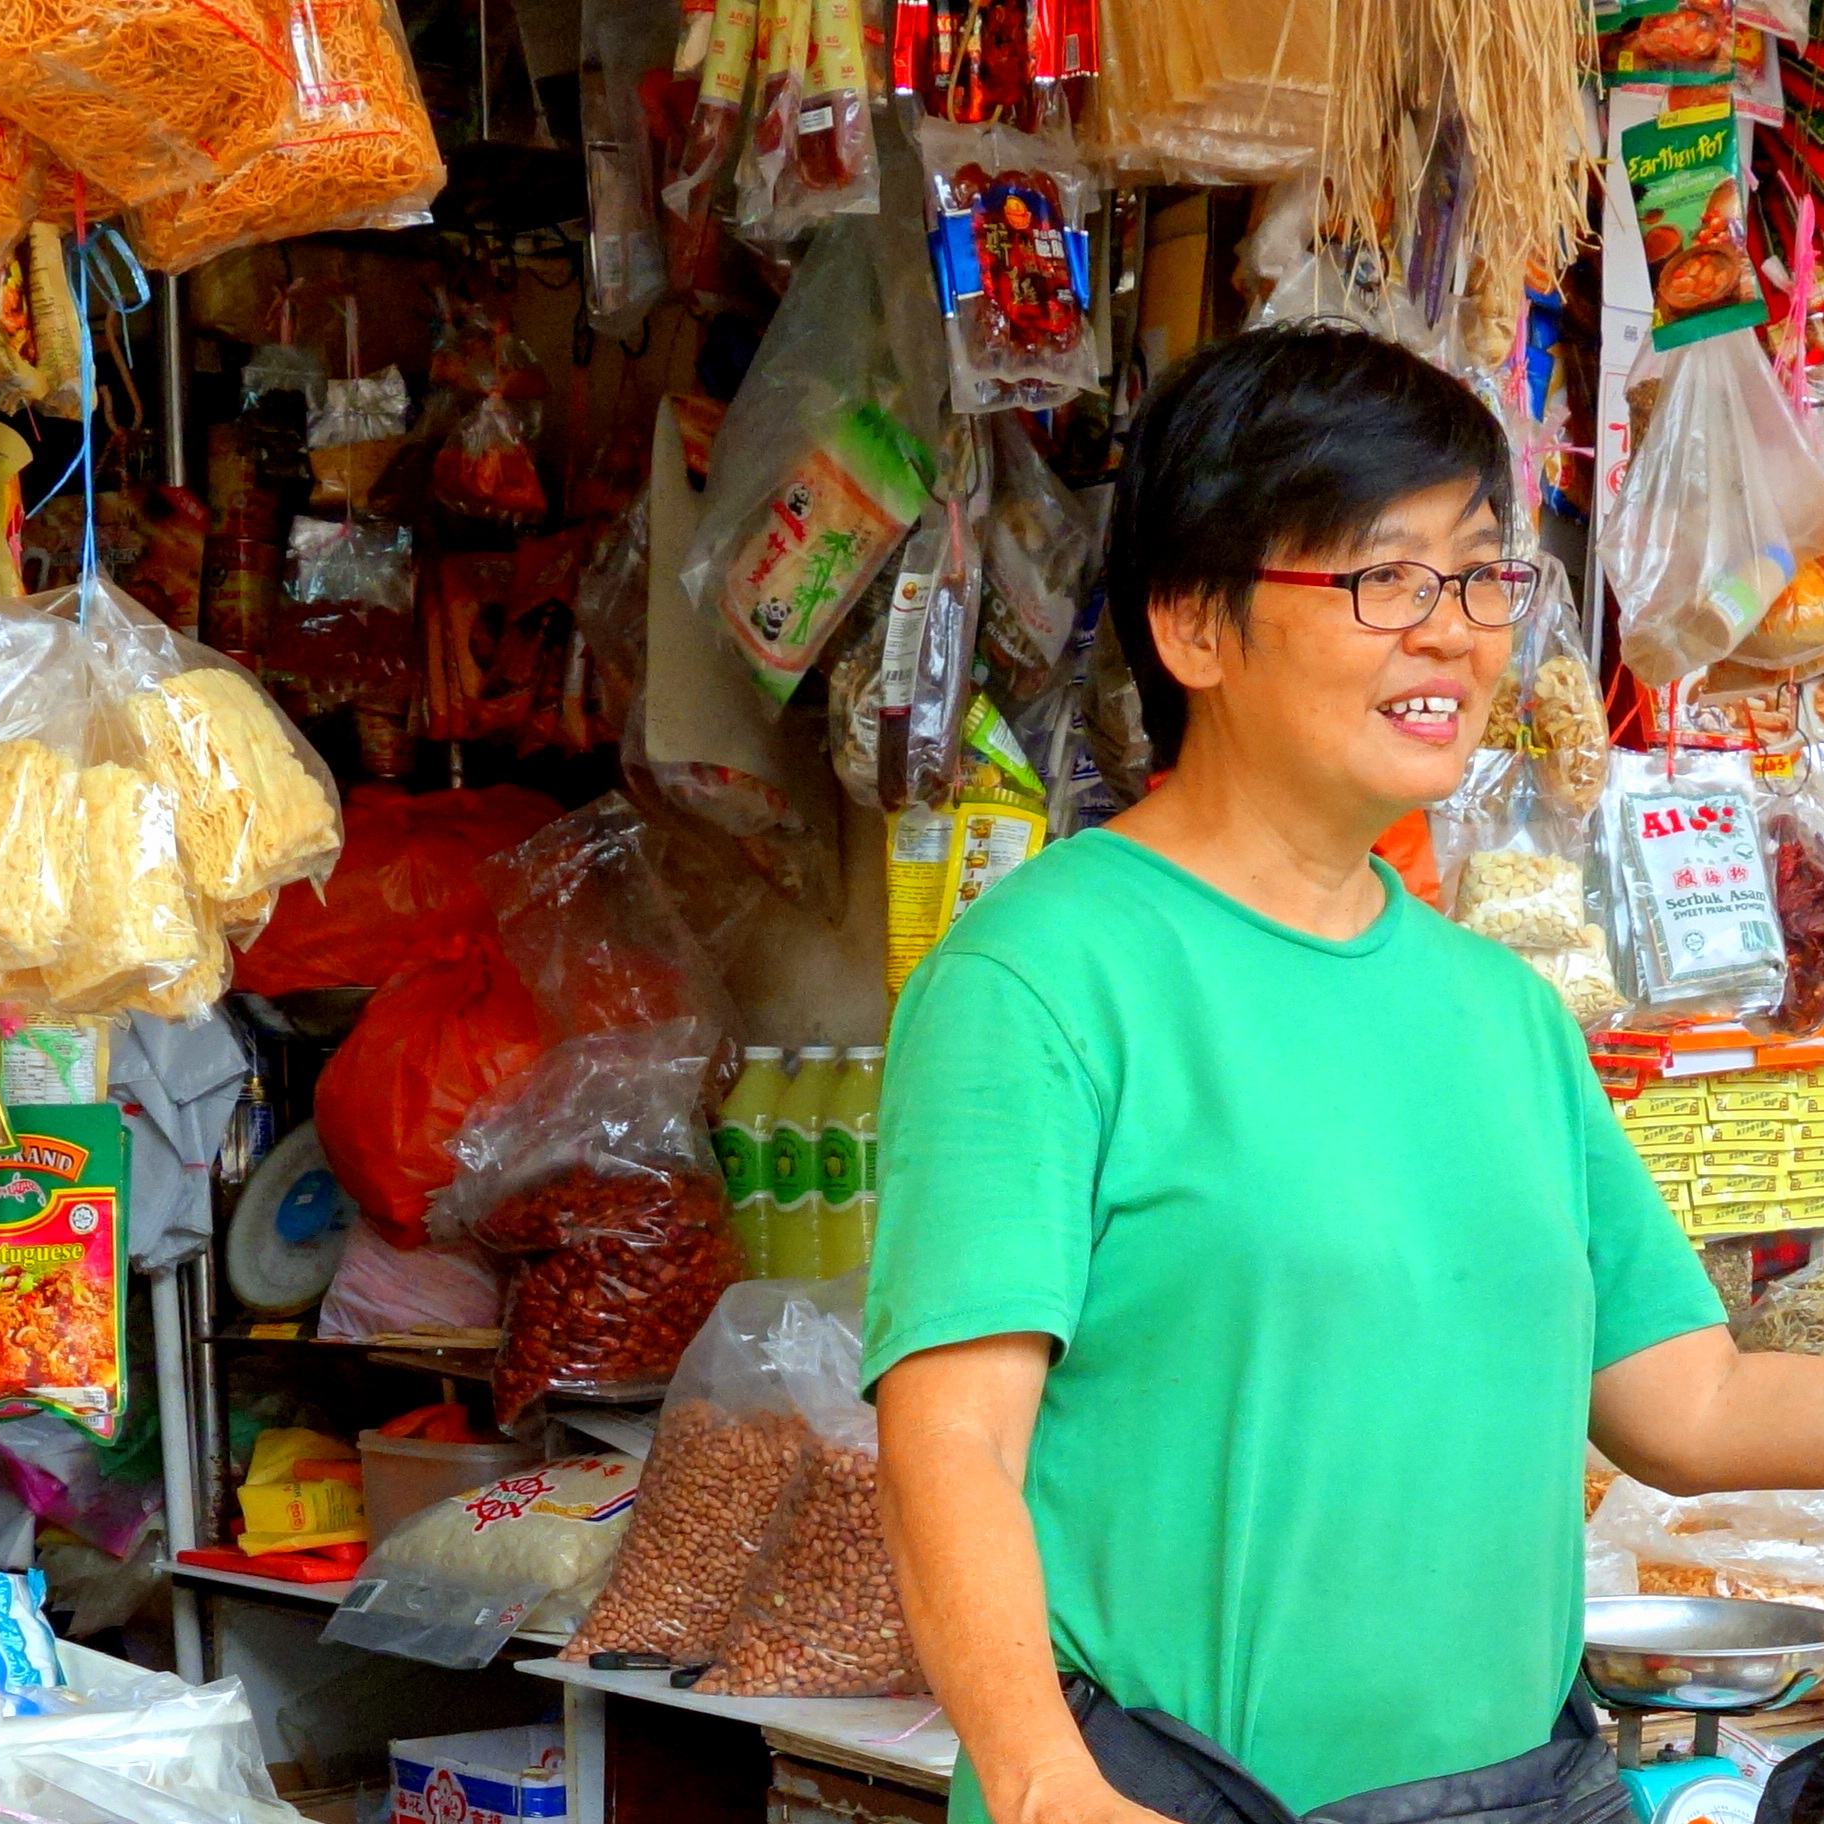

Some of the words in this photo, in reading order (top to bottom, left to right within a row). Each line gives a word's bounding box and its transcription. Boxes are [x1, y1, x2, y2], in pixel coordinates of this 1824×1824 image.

[1642, 808, 1684, 839] A1
[1666, 890, 1723, 911] Serbuk
[1730, 888, 1766, 903] Asam
[1674, 906, 1705, 921] SWEET
